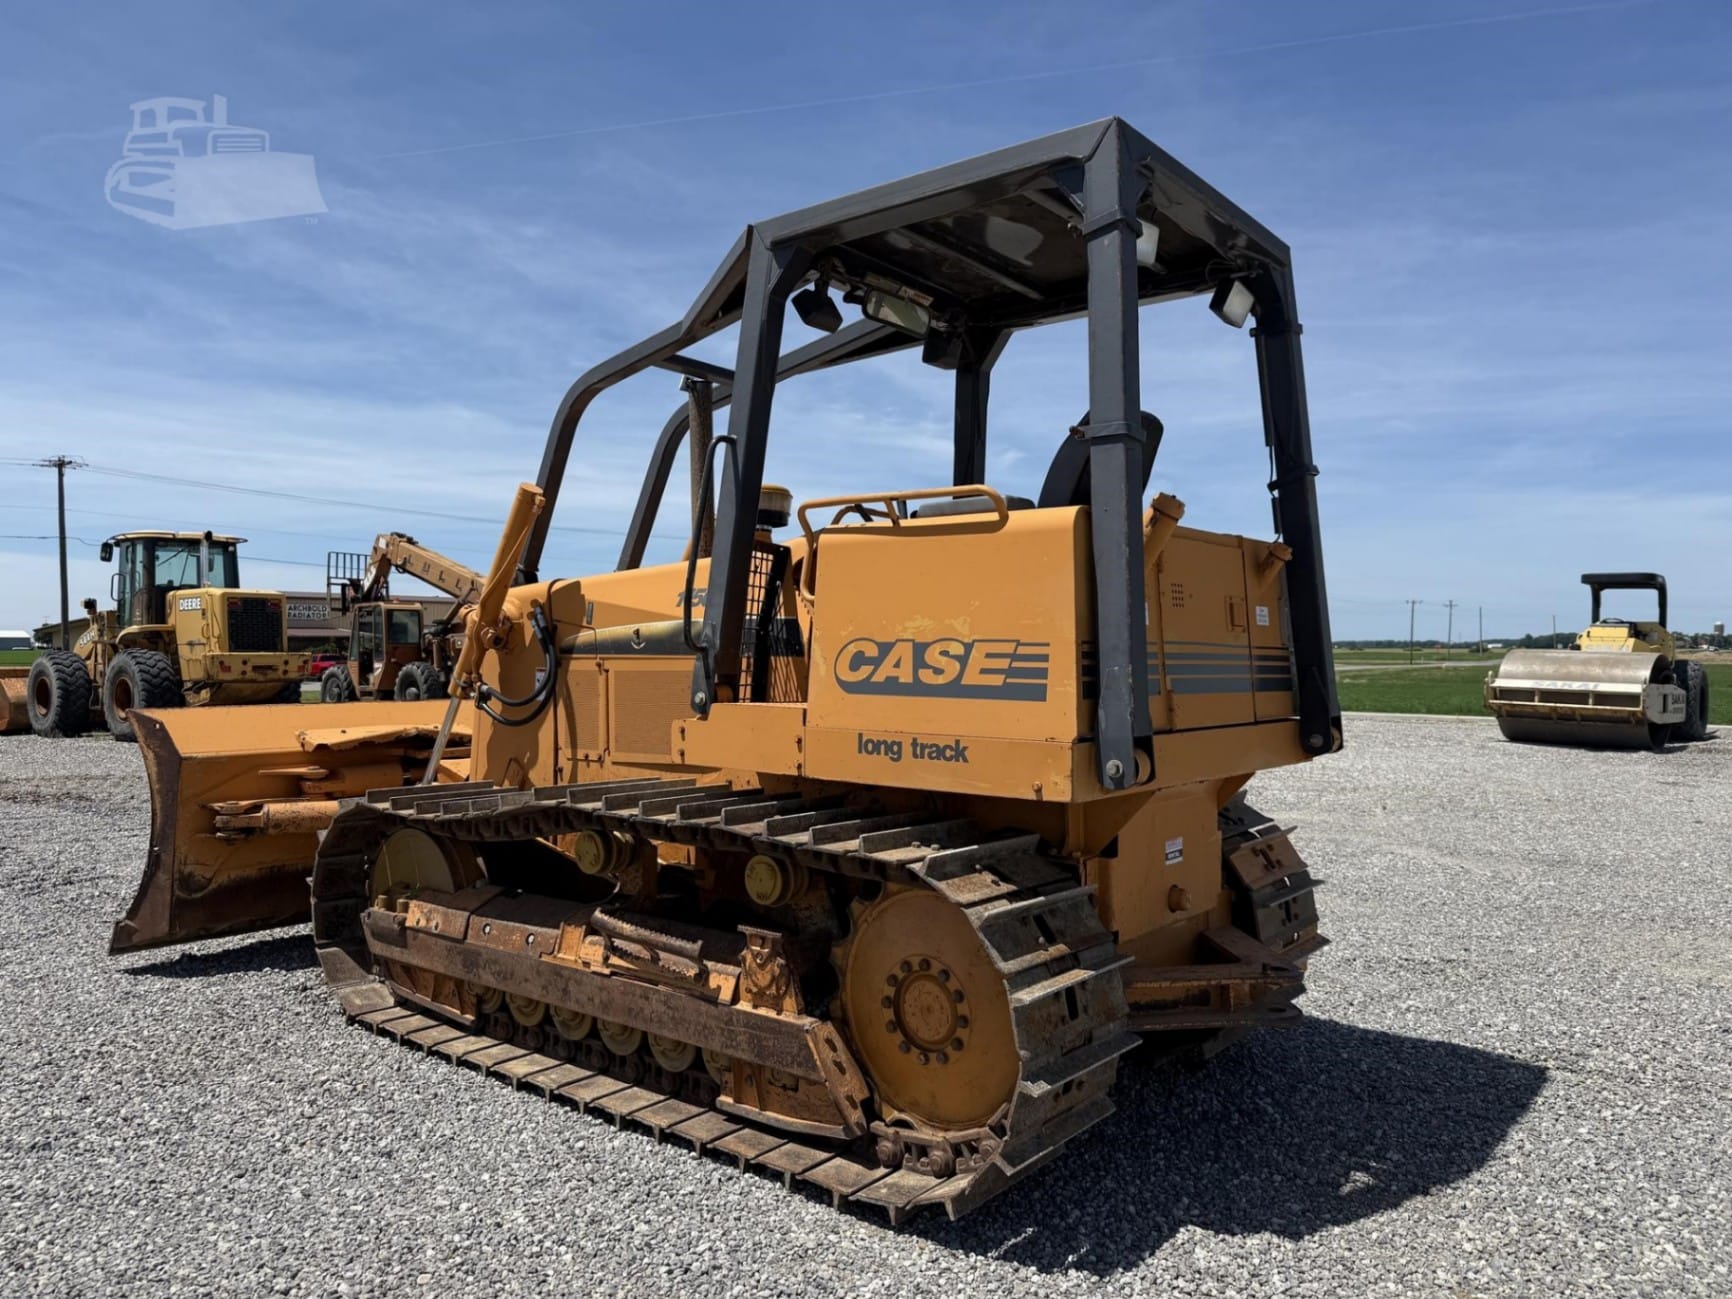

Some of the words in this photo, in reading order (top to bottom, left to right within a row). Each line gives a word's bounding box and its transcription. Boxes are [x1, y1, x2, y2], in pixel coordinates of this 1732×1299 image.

[179, 597, 202, 611] DEERE
[287, 604, 328, 612] ARCHBOLD
[834, 637, 1024, 689] CASE
[857, 733, 903, 762] long
[910, 737, 969, 763] track
